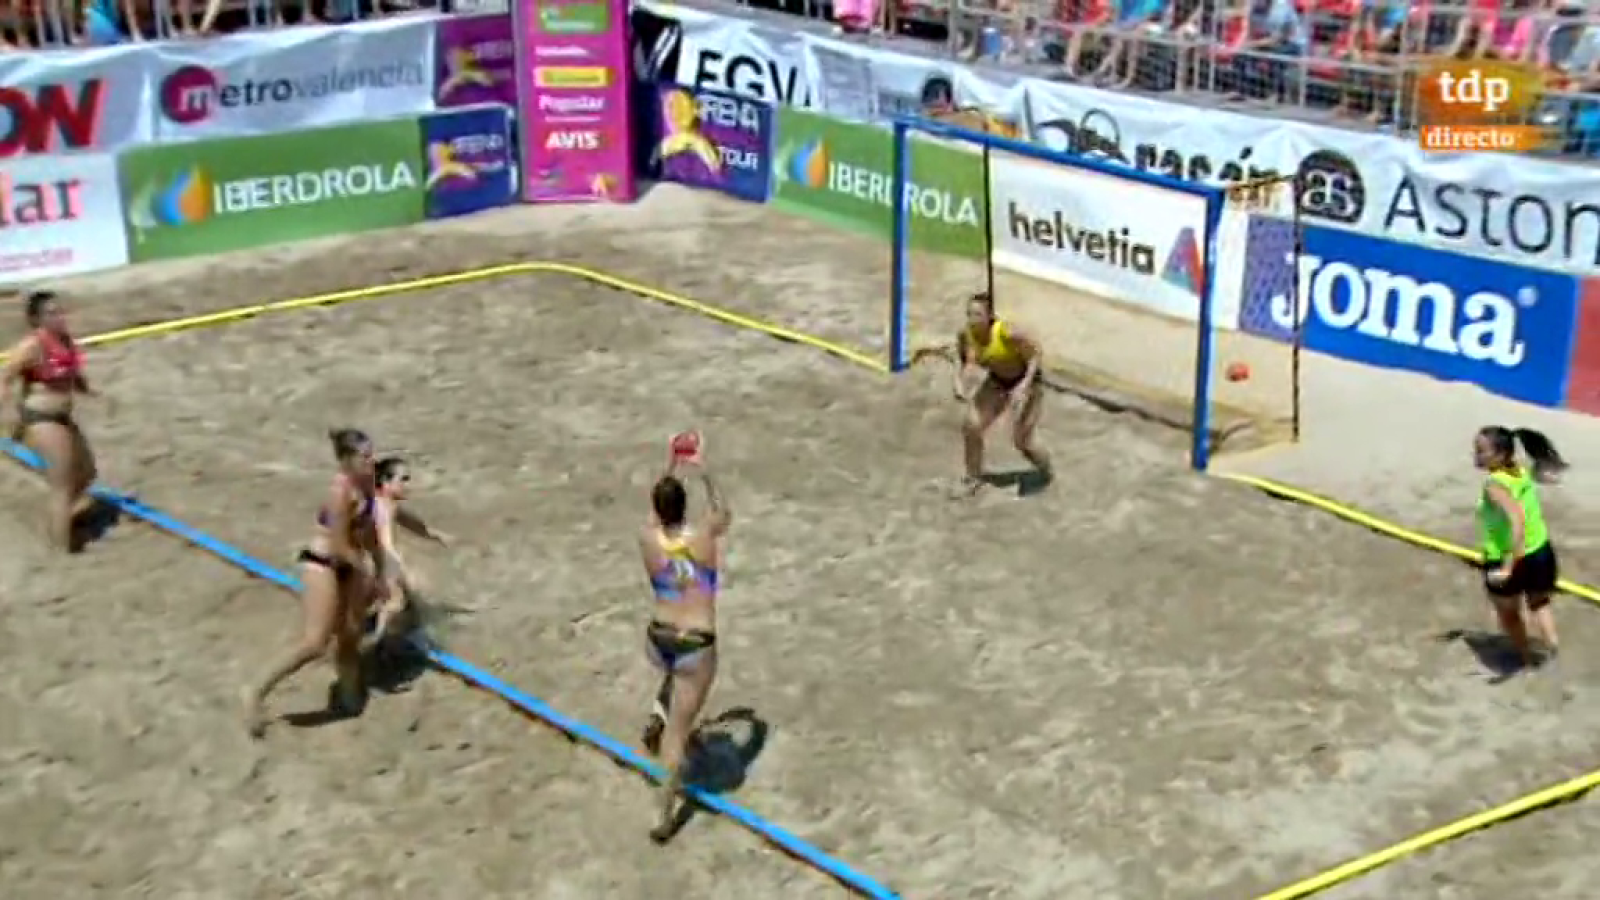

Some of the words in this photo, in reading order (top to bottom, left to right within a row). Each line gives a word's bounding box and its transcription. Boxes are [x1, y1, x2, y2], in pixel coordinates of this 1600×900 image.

[545, 131, 599, 149] AVIS
[214, 160, 415, 214] IBERDROLA
[828, 161, 978, 226] IBERROLA
[1384, 173, 1600, 265] Aston
[1008, 201, 1156, 275] helvetia
